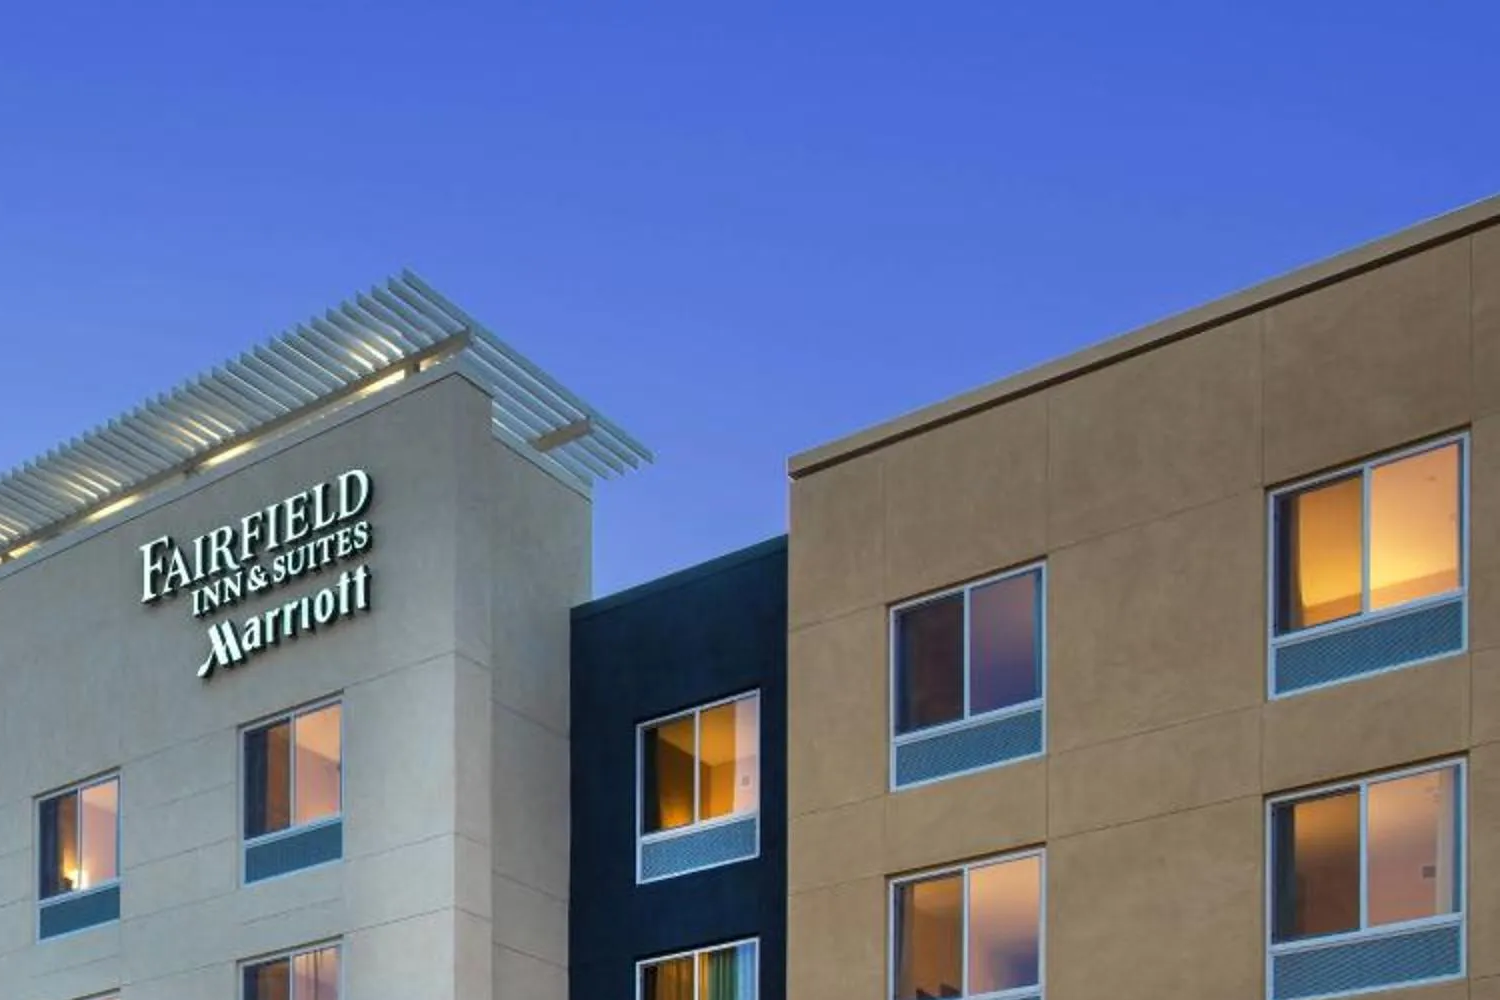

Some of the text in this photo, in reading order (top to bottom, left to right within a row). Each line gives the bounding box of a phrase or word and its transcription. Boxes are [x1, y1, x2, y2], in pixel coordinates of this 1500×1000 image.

[139, 468, 371, 603] FAIRFIELD
[192, 520, 371, 617] INN & SUITES
[196, 563, 371, 678] Marriott
